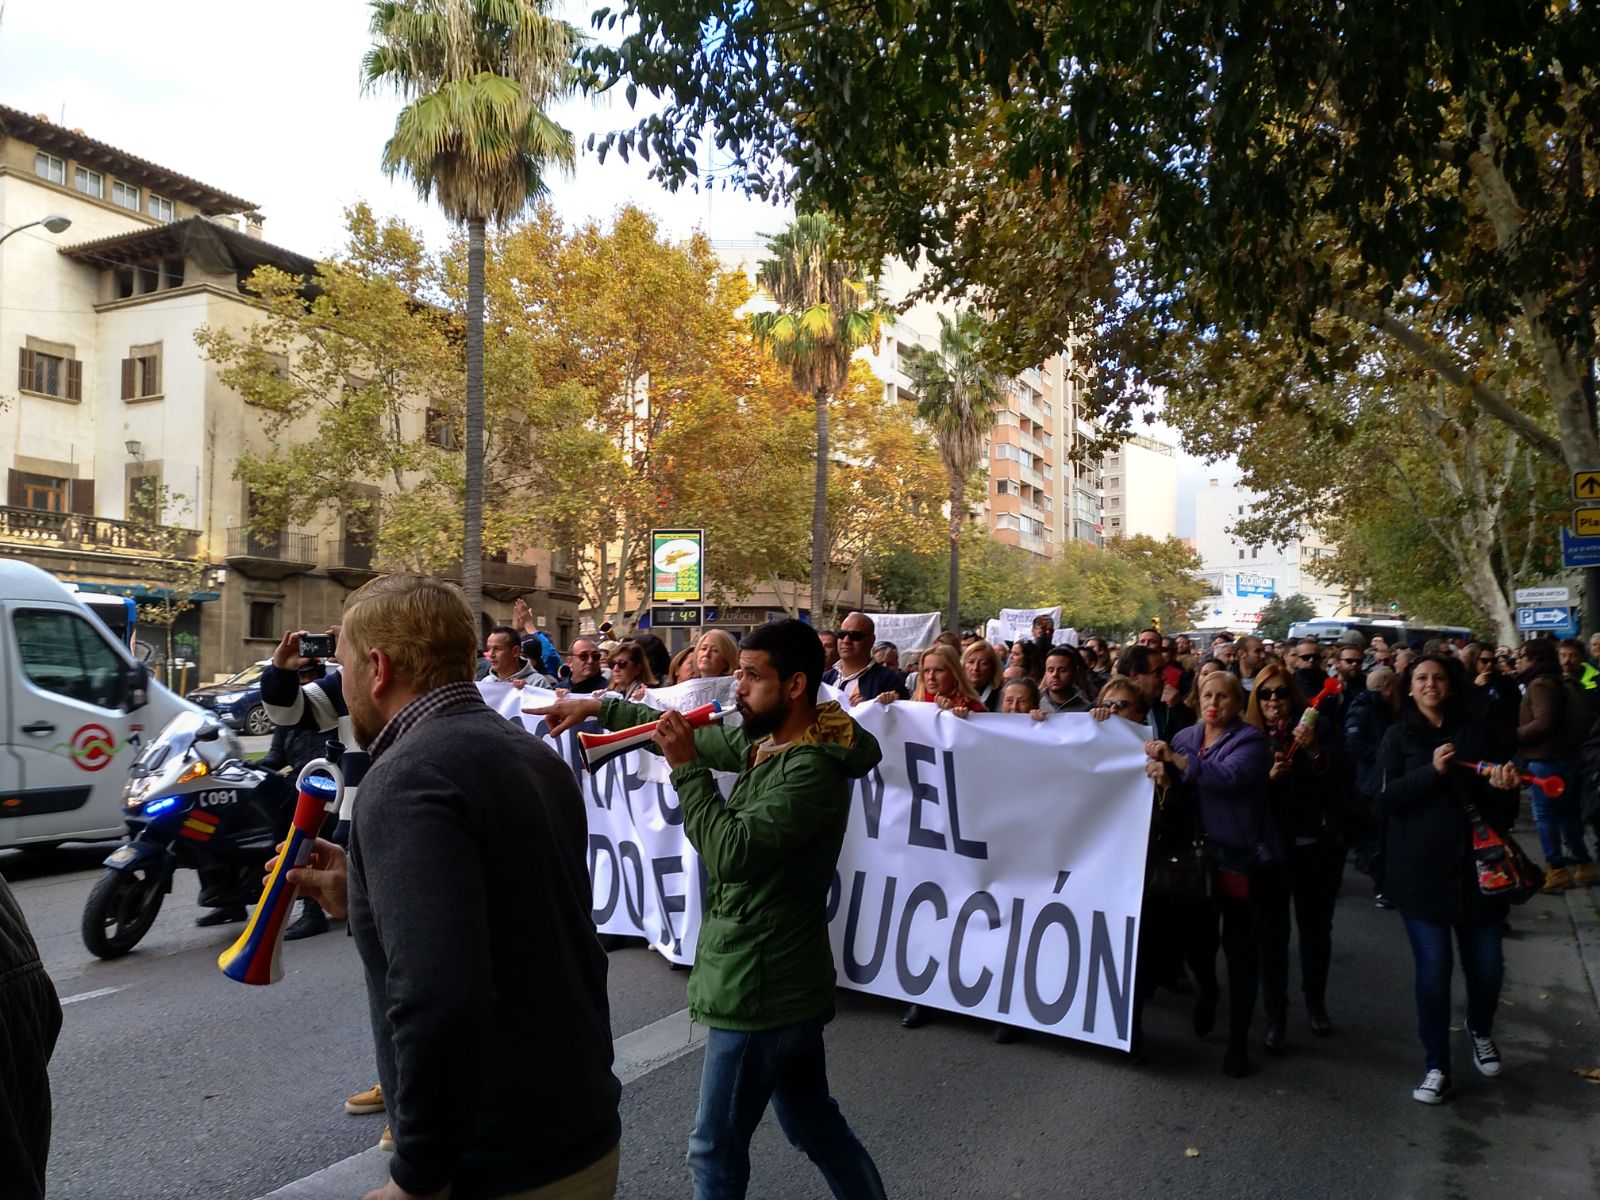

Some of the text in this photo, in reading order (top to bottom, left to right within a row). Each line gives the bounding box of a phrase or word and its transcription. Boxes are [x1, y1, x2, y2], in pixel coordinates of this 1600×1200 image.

[1239, 575, 1273, 588] DECATHLON
[719, 612, 756, 621] ZURICH
[904, 741, 989, 860] EL
